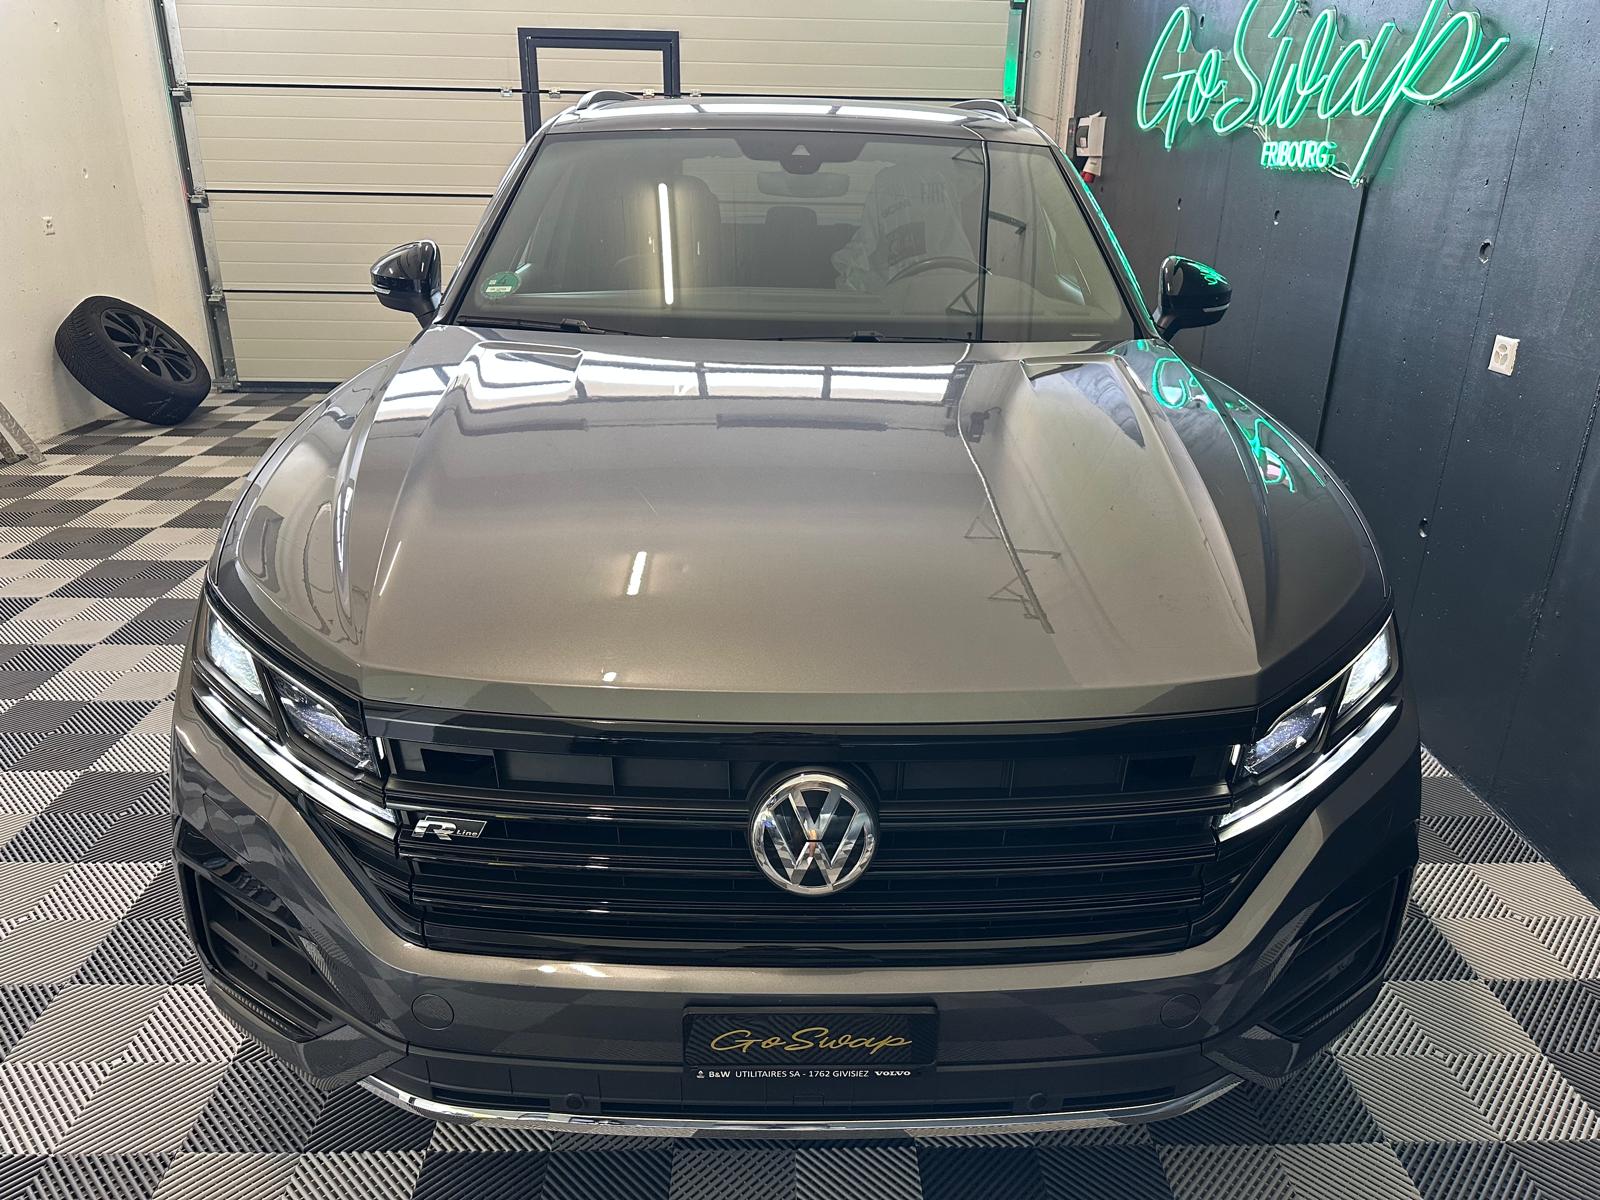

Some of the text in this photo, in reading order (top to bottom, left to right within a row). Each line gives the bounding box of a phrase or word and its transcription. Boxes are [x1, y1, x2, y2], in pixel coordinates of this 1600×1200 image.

[1260, 140, 1337, 169] FRIBOURG
[456, 829, 479, 837] Line
[708, 1070, 731, 1078] B&W
[735, 1070, 787, 1078] UTILITAIRES
[789, 1070, 801, 1078] SA
[808, 1070, 830, 1078] 1762
[832, 1070, 869, 1078] GIVISIEZ
